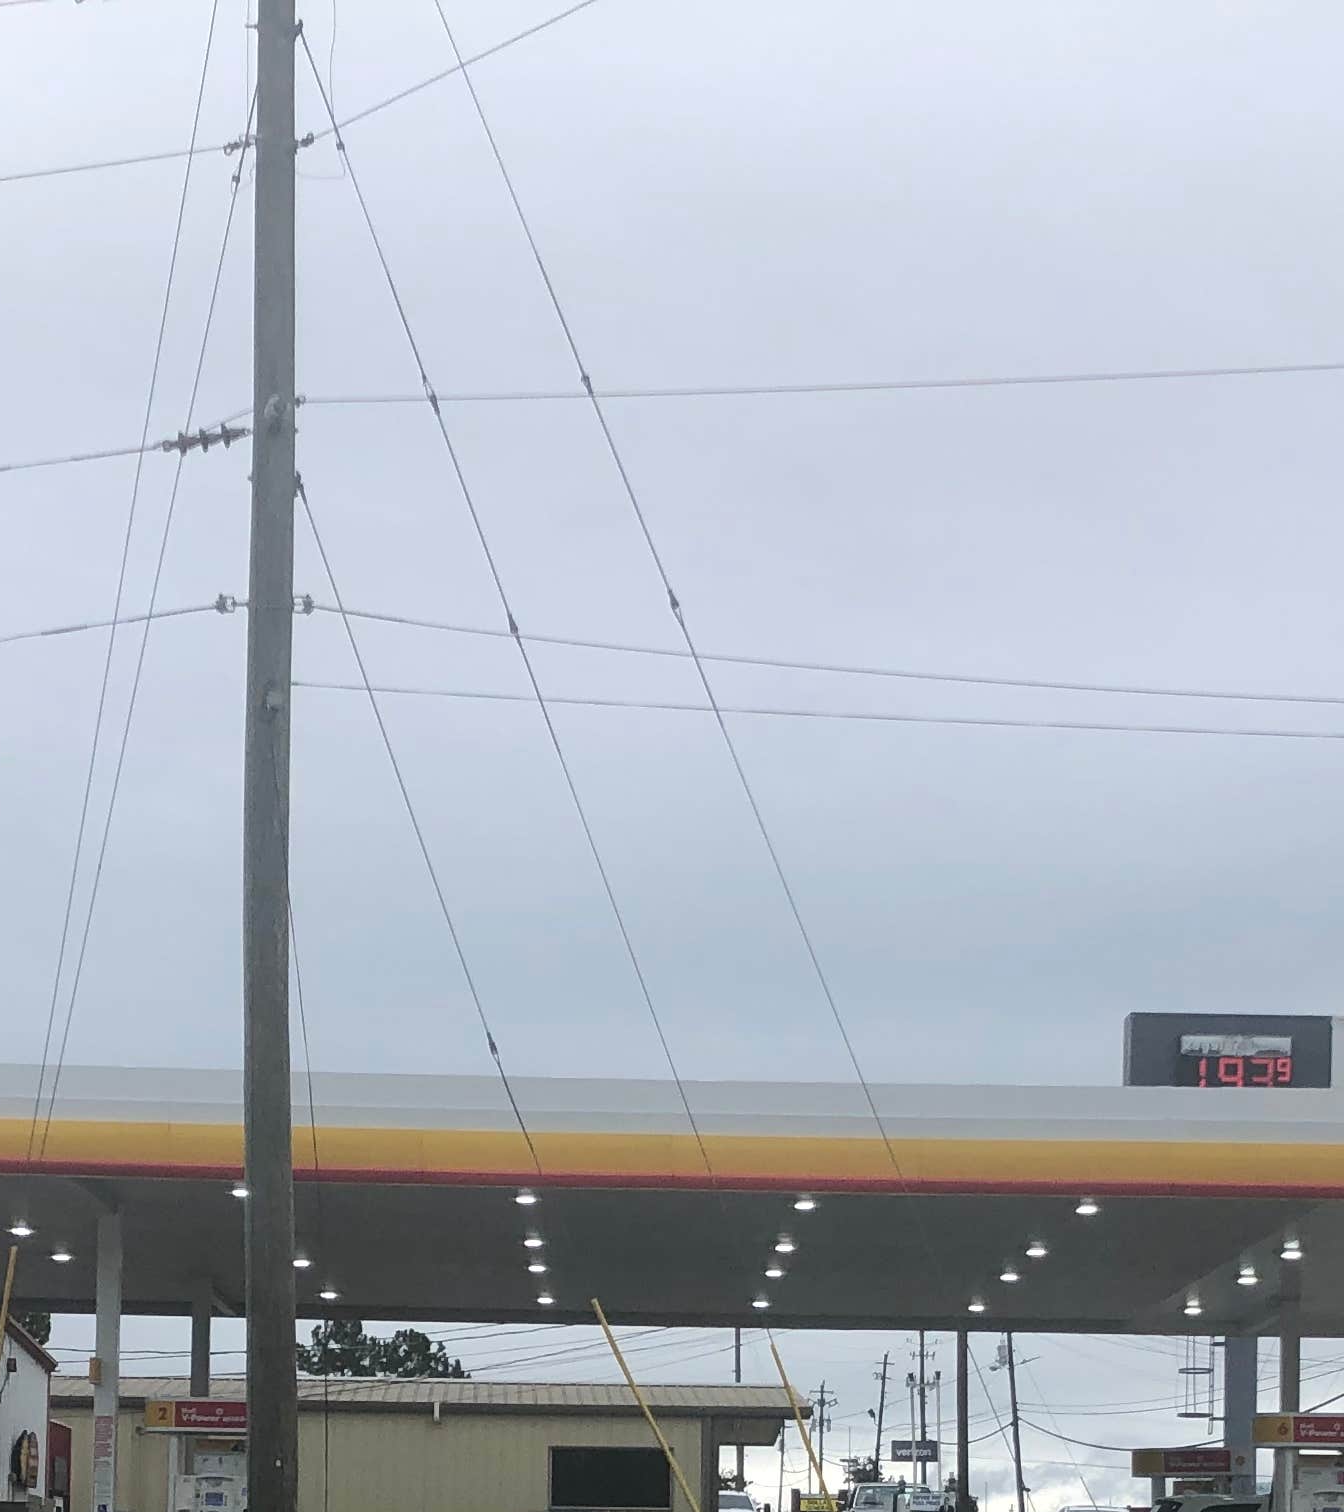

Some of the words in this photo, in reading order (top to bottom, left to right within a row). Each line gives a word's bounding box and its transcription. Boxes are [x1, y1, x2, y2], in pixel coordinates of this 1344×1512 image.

[158, 1407, 167, 1420] 2
[1278, 1422, 1289, 1435] 6
[896, 1448, 932, 1456] verzon
